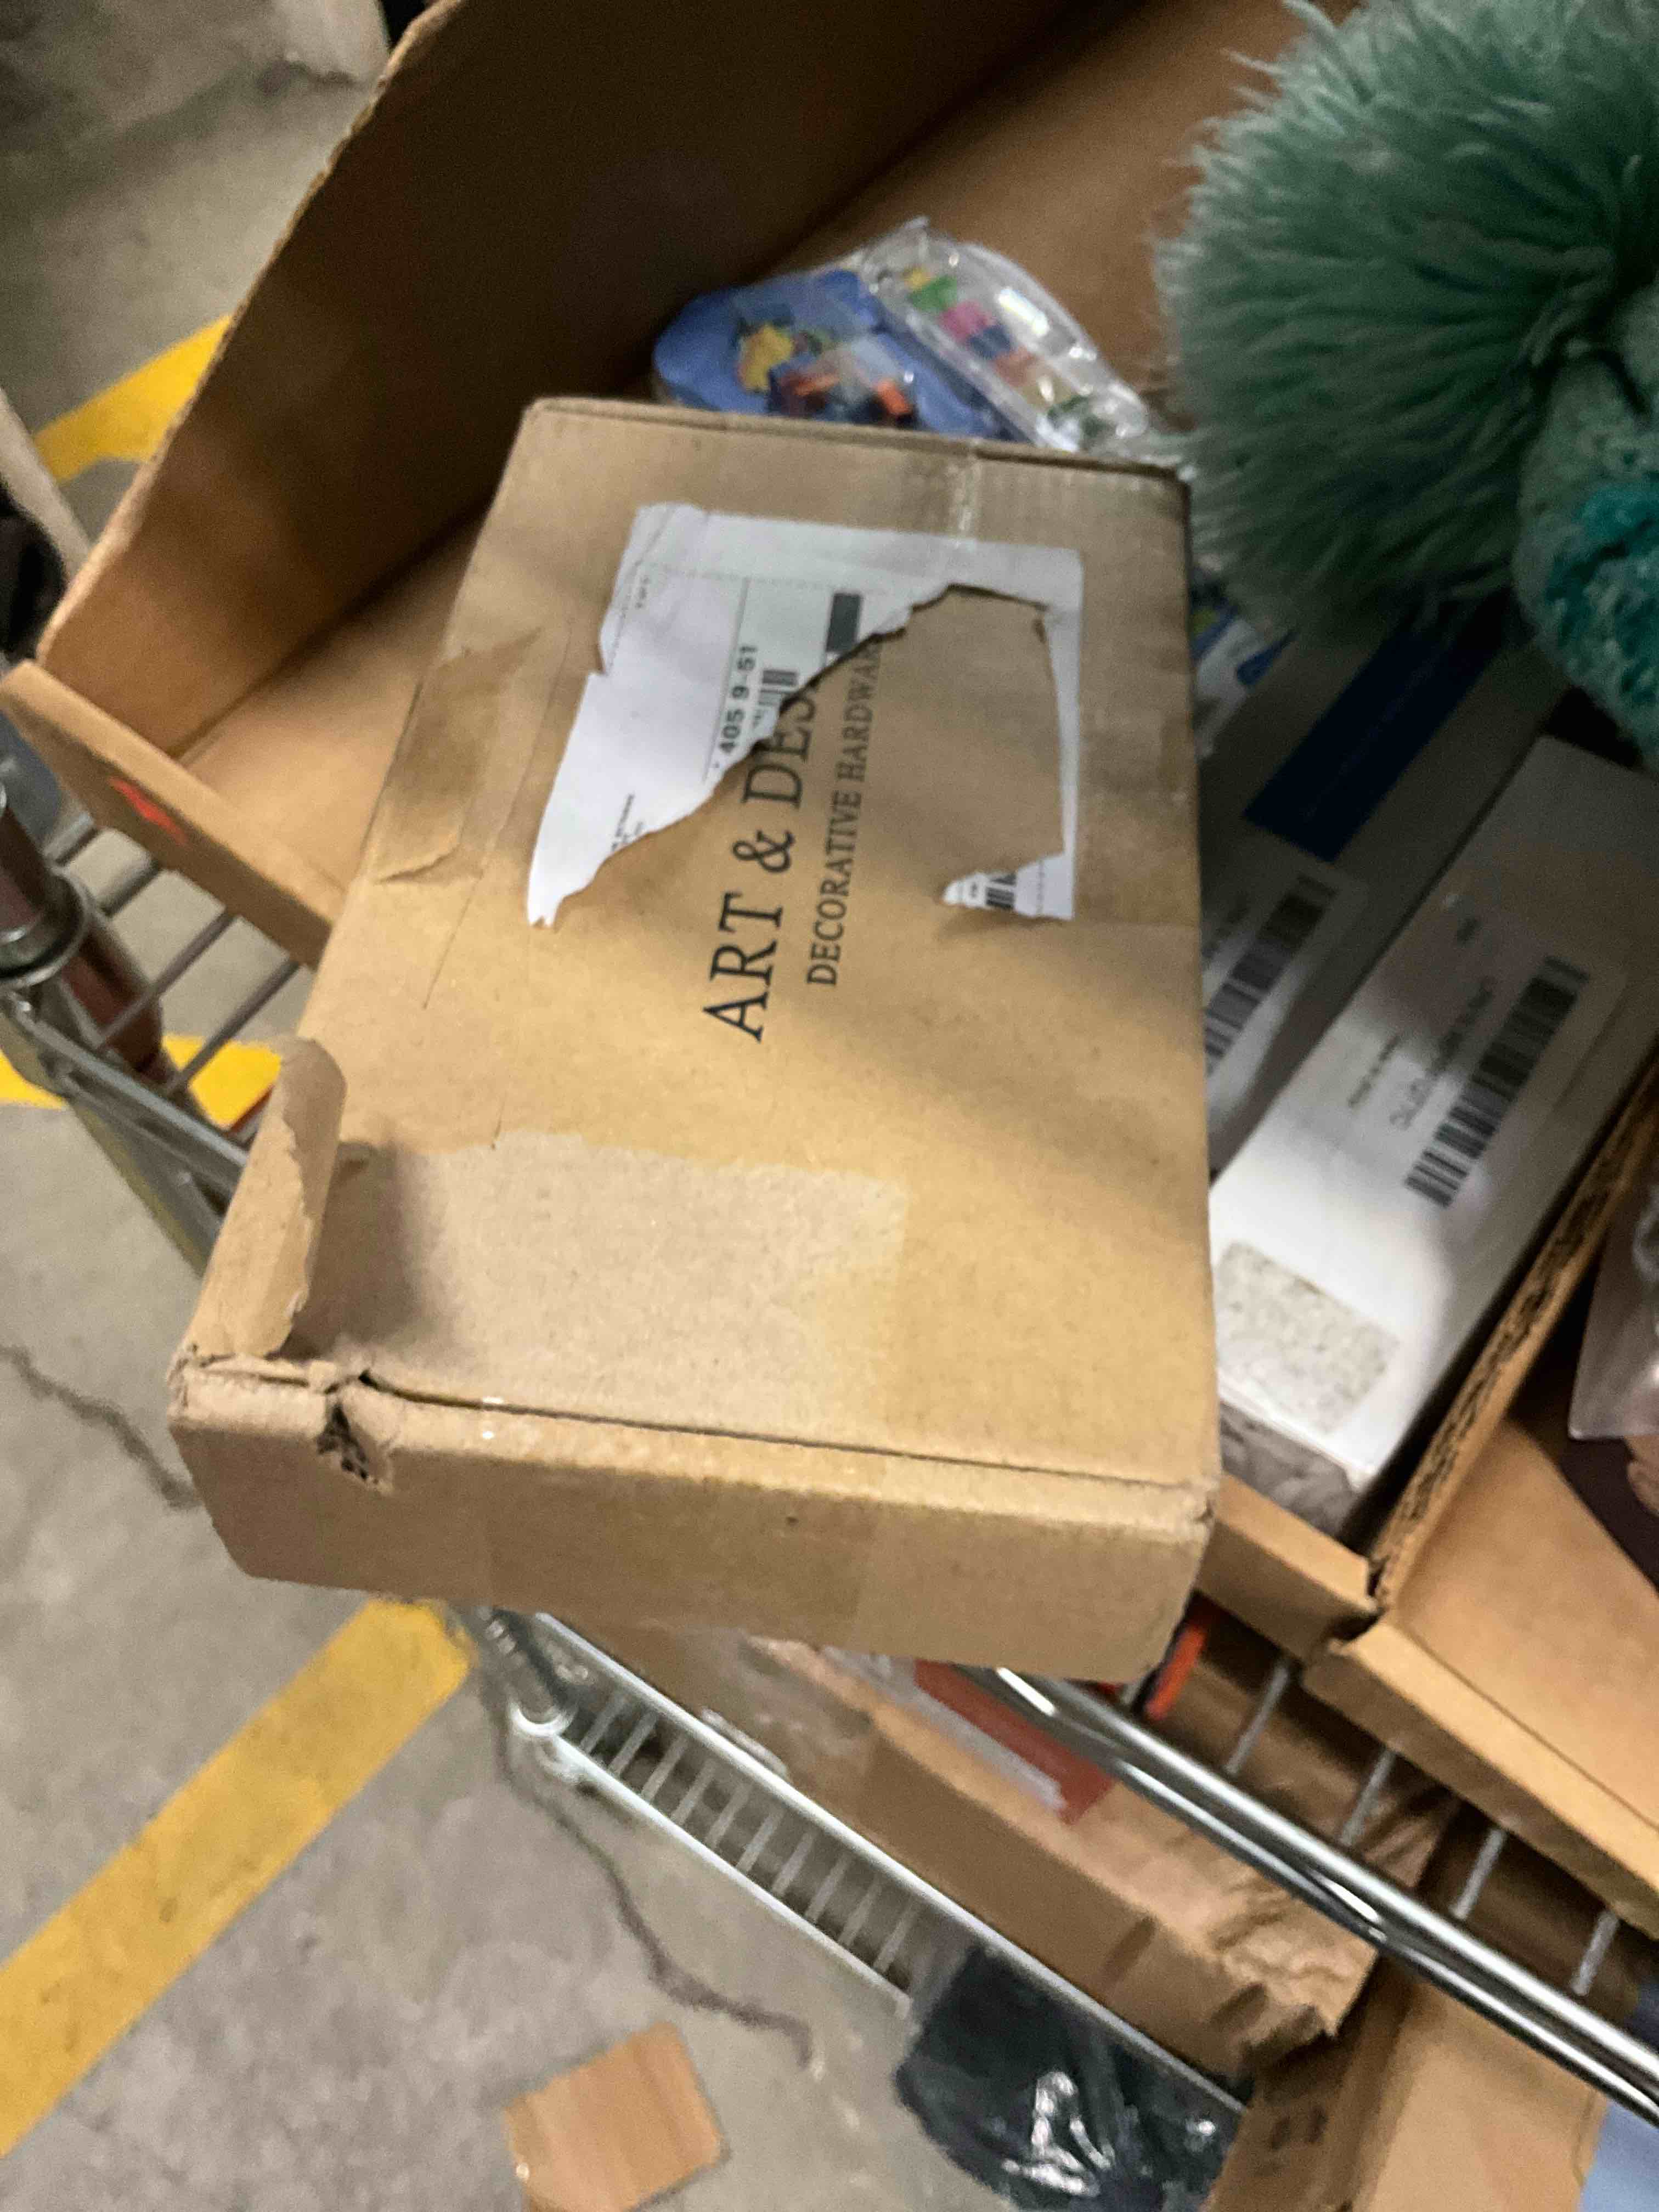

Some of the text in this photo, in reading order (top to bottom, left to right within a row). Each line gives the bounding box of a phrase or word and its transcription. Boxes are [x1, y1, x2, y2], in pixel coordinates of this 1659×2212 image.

[731, 644, 757, 699] 9-51
[718, 708, 745, 753] 405
[732, 829, 795, 874] &
[806, 790, 862, 986] DECORATIVE
[702, 888, 783, 1042] ART
